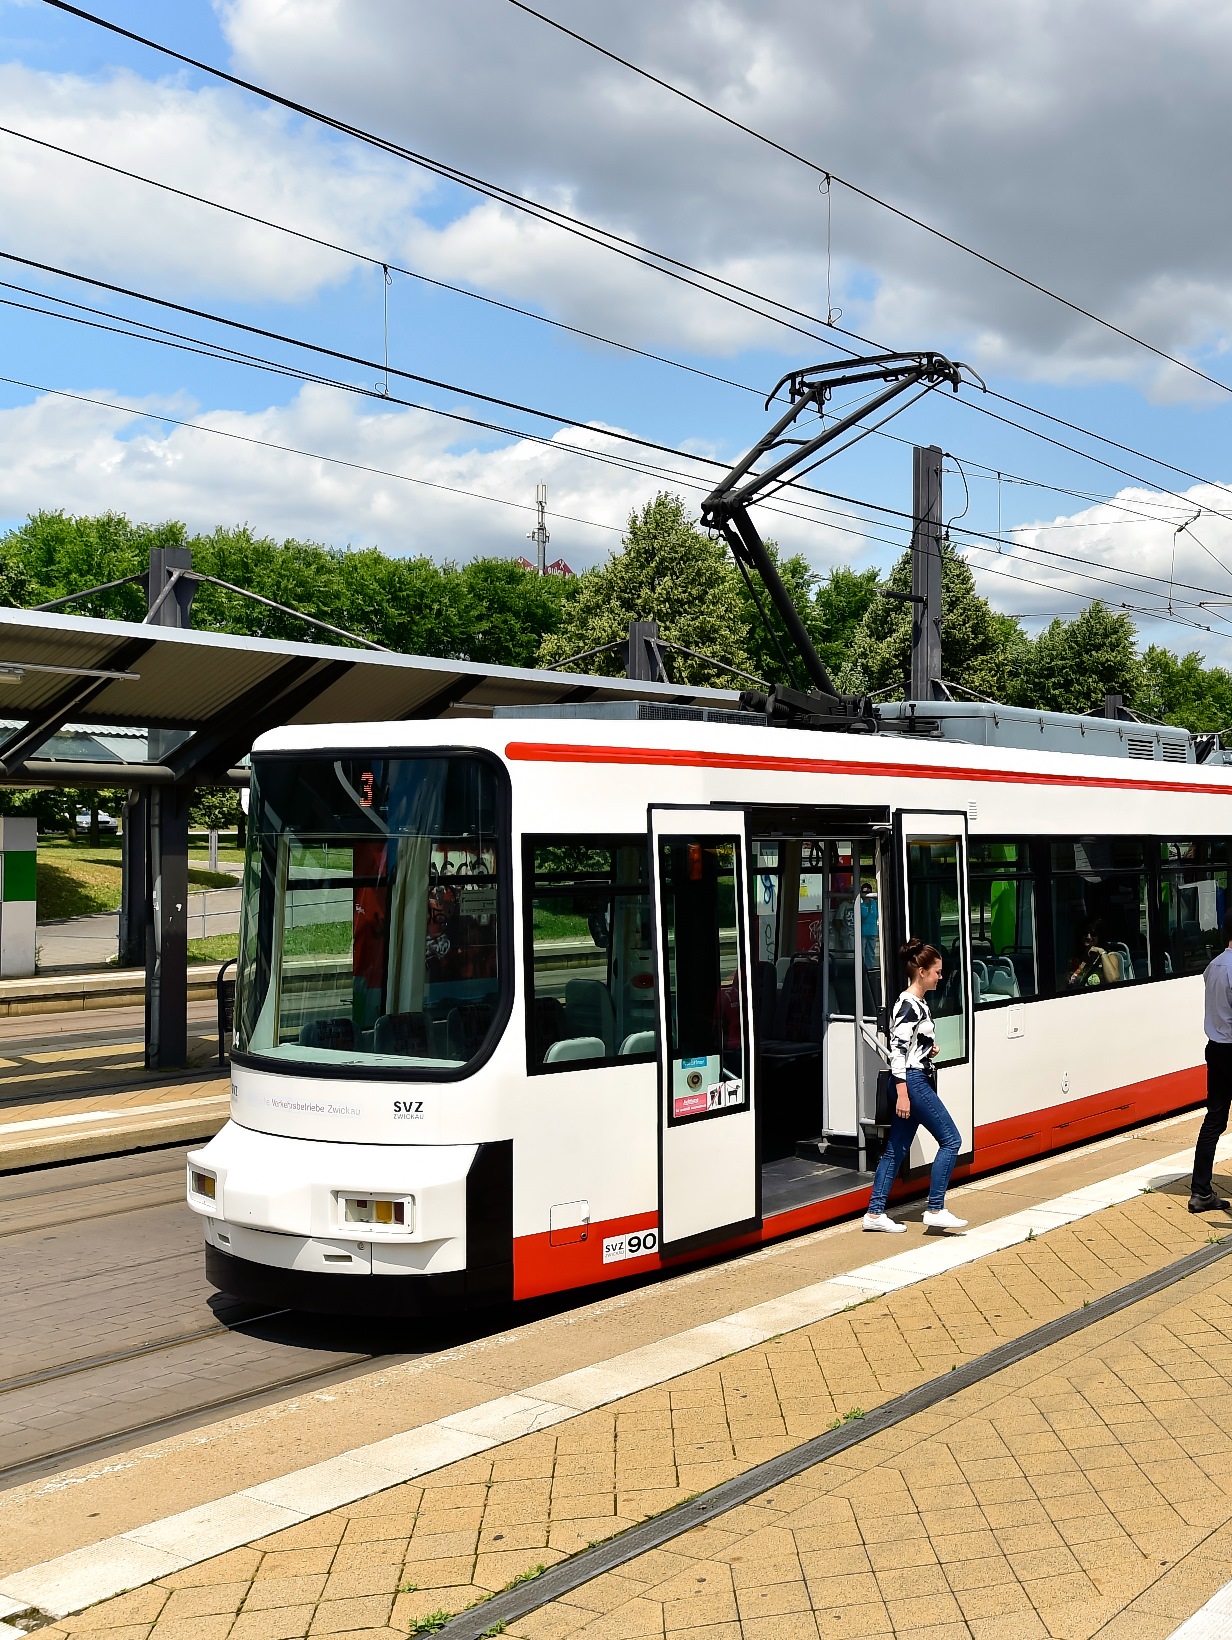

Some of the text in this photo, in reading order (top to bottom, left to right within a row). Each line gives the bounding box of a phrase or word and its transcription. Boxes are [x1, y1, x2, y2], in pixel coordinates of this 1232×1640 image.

[360, 772, 374, 807] 3
[271, 1098, 325, 1113] Verkehrsbetriebe
[327, 1104, 361, 1116] Zwickau
[393, 1100, 424, 1113] SVZ
[605, 1241, 625, 1253] SVZ
